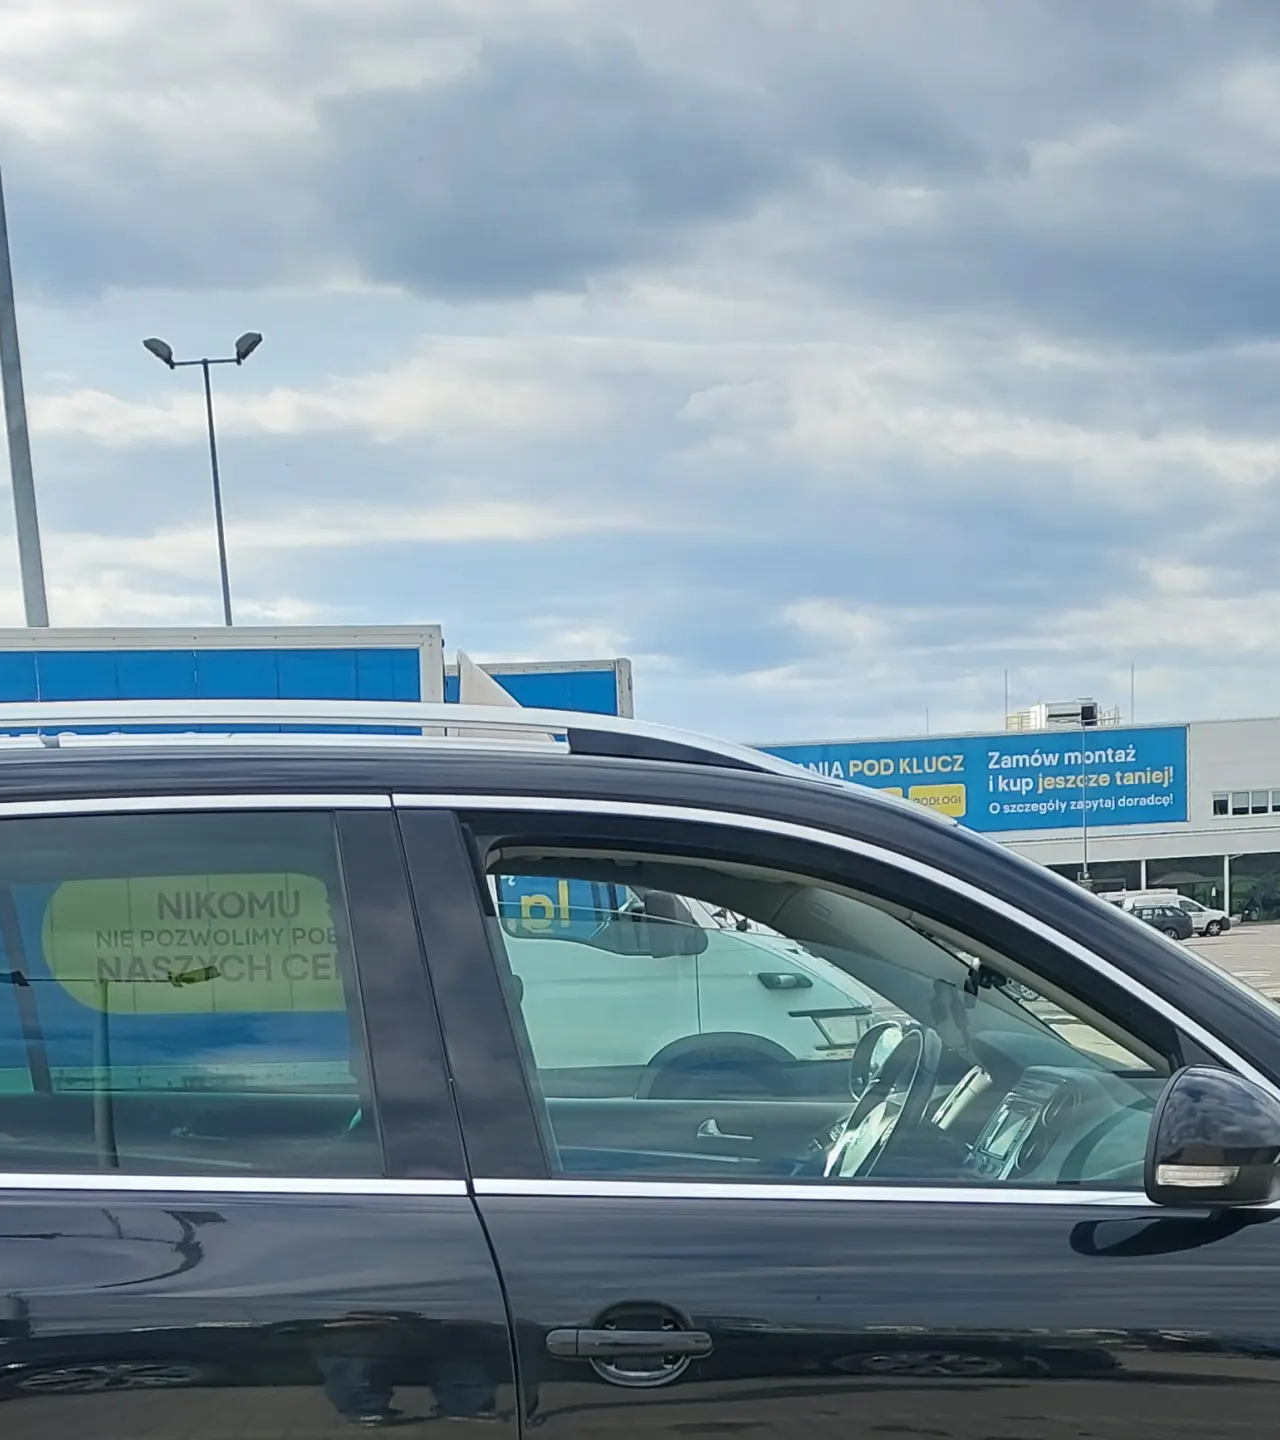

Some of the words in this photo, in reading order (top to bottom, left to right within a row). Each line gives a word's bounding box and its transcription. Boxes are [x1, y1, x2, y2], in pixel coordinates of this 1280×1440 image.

[849, 758, 894, 777] POD
[900, 754, 965, 774] KLUCZ
[988, 749, 1060, 769] Zamów
[1064, 744, 1136, 765] montaż
[988, 775, 994, 792] i
[998, 774, 1033, 795] kup
[1037, 772, 1110, 794] jeszcze
[1114, 766, 1174, 792] taniej!
[989, 802, 1000, 815] O
[1003, 798, 1067, 815] szczegóły
[1070, 796, 1115, 811] zapytaj
[1118, 793, 1174, 807] doradcę!
[157, 890, 300, 920] NIKOMU
[96, 930, 132, 948] NIE
[141, 927, 284, 947] POZWOLIMY
[97, 953, 270, 982] NASZYCH
